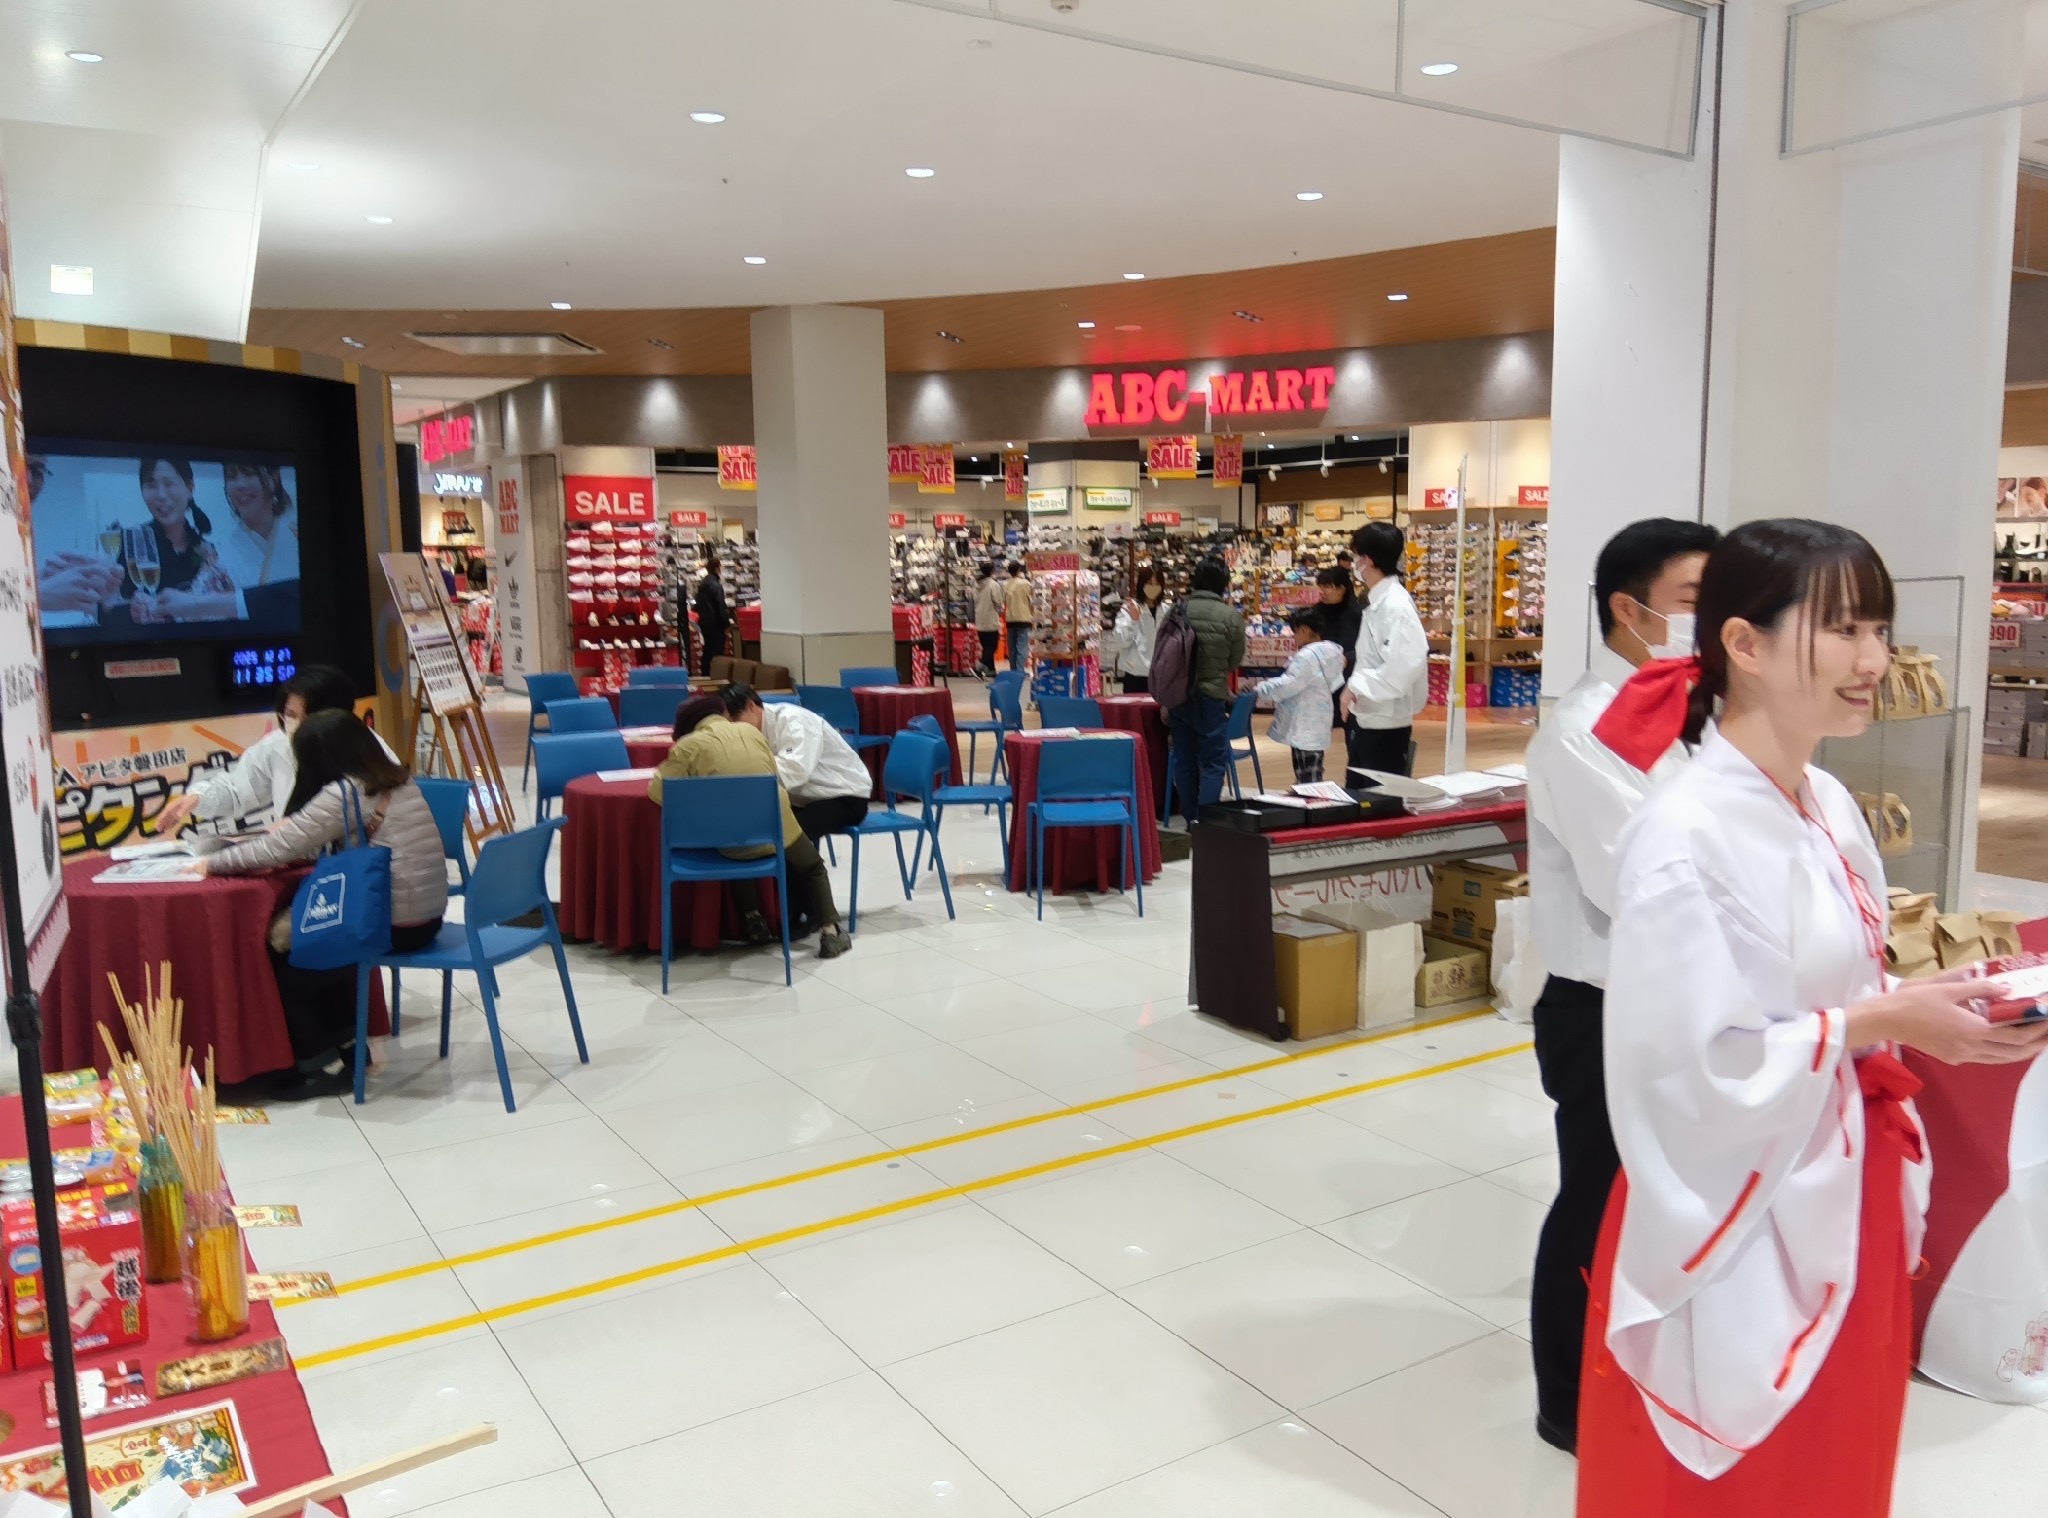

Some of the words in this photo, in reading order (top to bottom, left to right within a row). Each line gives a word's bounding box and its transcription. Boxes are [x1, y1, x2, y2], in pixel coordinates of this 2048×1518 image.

[1085, 366, 1335, 425] ABC-MART
[888, 450, 920, 473] ALE
[1151, 448, 1193, 469] SALE
[923, 464, 952, 486] SALE
[574, 491, 645, 516] SALE
[677, 512, 700, 523] SALE
[1152, 513, 1173, 523] SALE
[79, 747, 187, 782] アピタ磐田店
